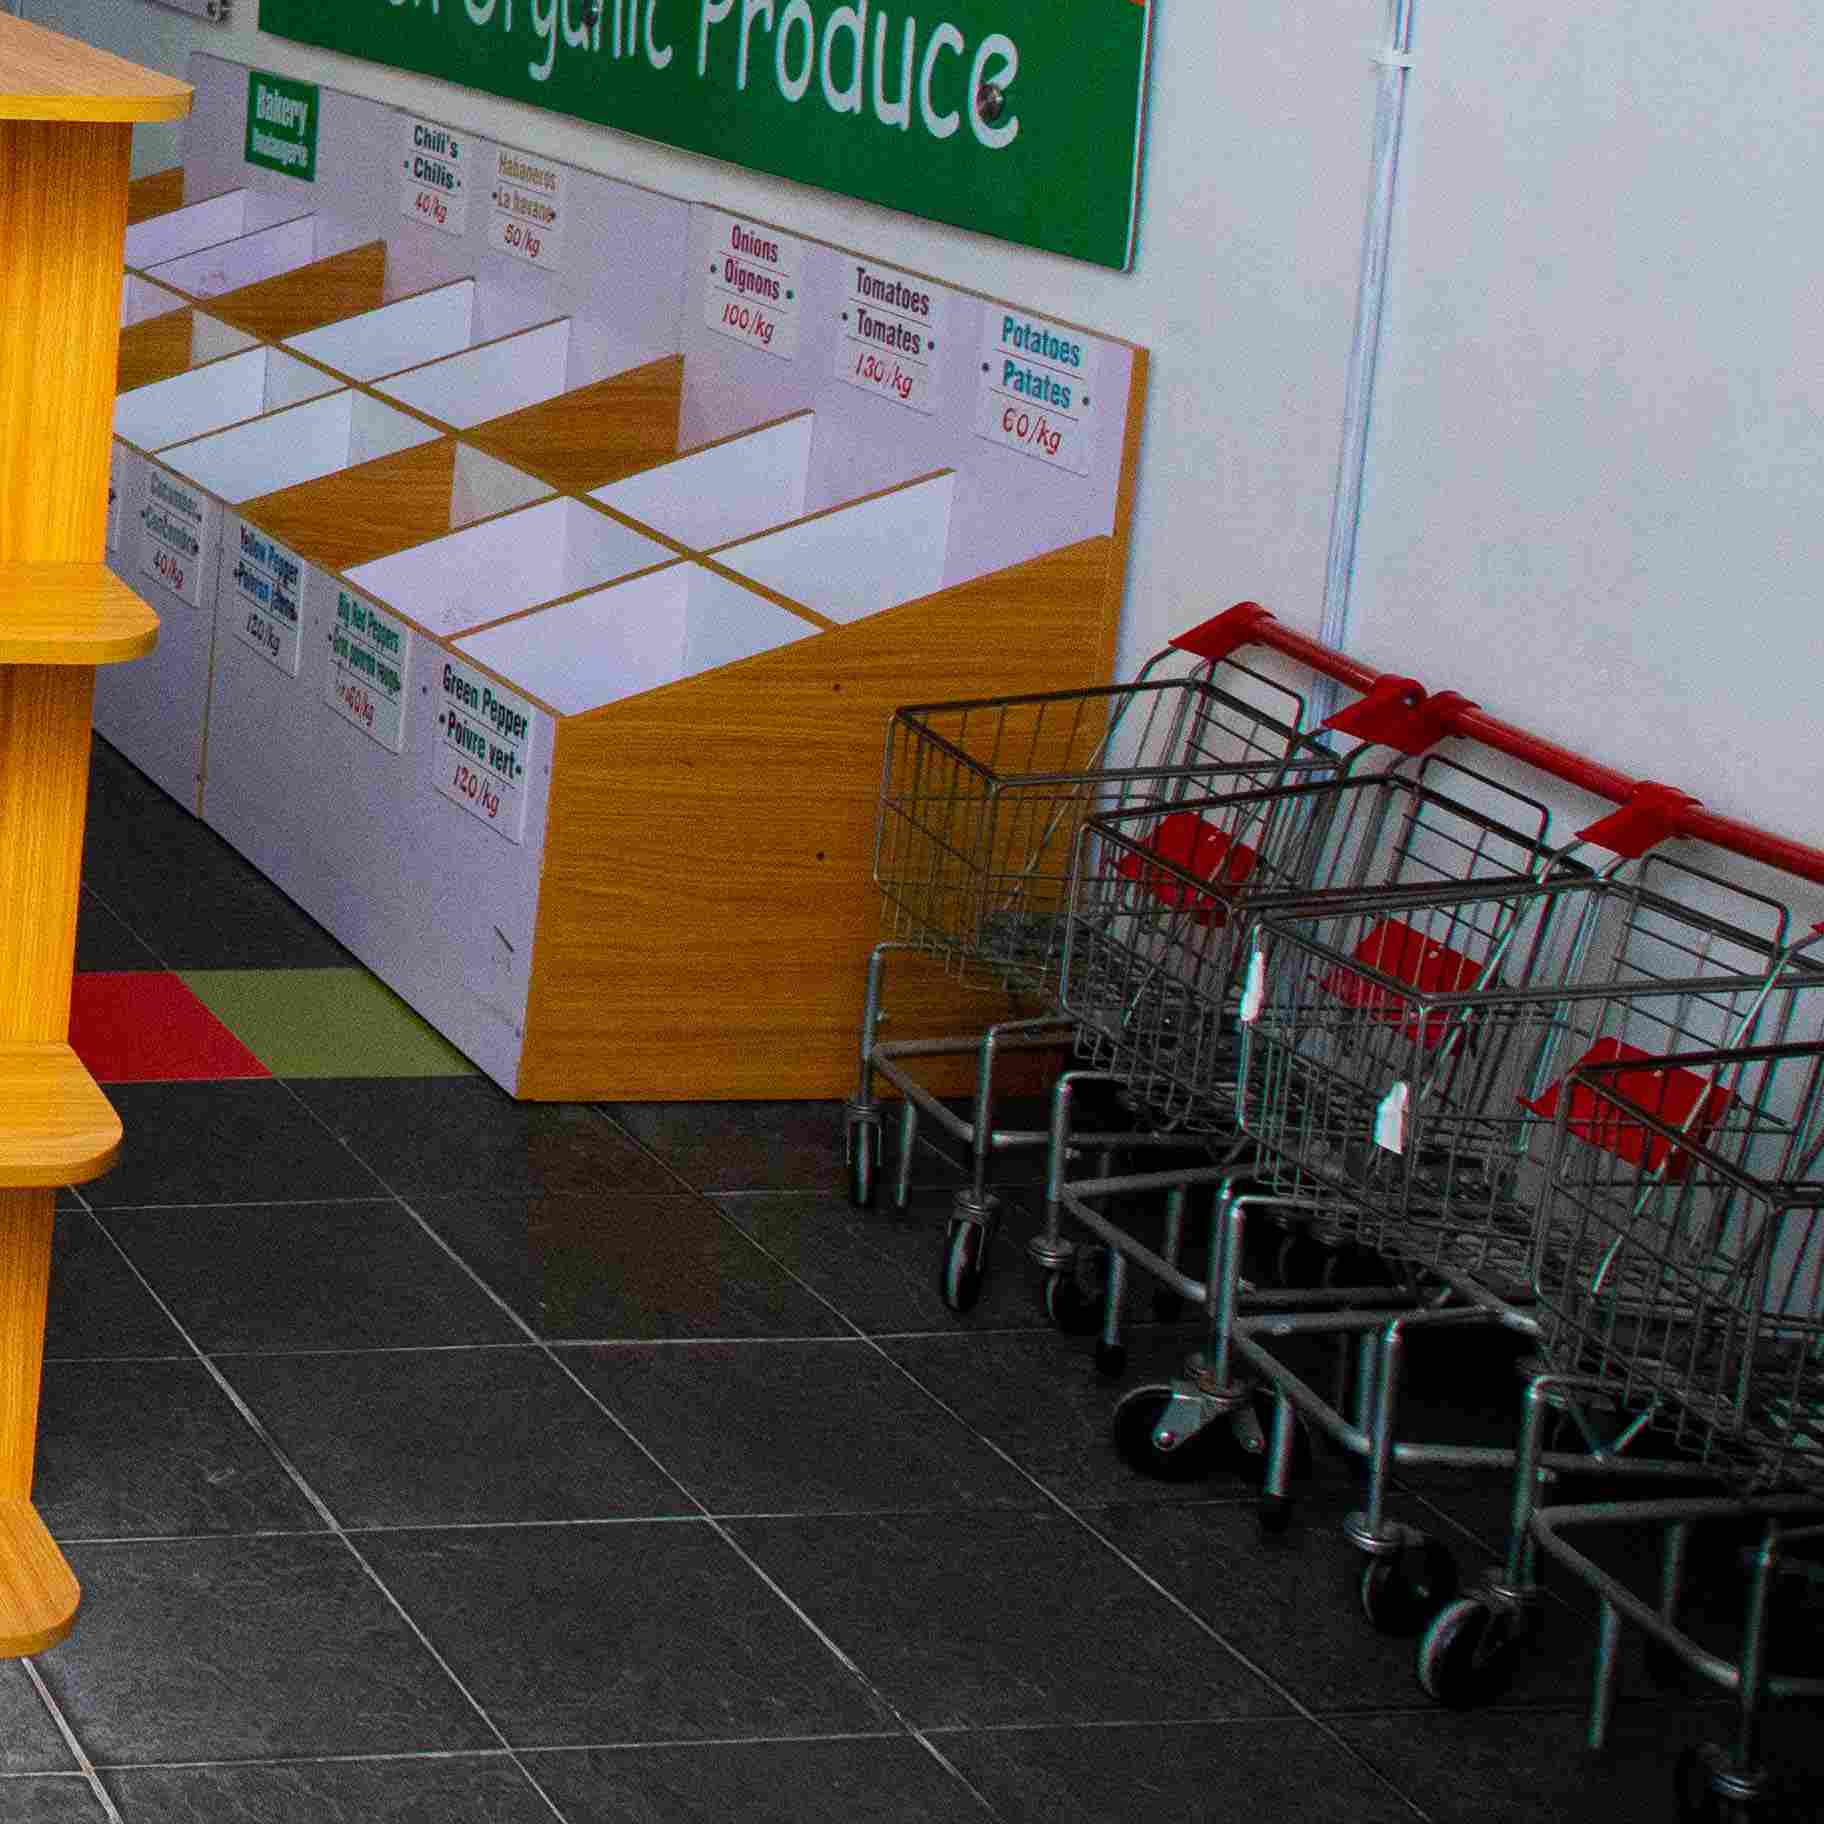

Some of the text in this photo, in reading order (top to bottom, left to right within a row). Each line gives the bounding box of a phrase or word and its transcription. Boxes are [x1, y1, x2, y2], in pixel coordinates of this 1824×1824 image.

[255, 82, 309, 136] Bakery
[731, 224, 779, 265] Onions
[724, 257, 781, 303] Oignons
[856, 266, 930, 318] Tomatoes
[720, 302, 776, 345] 100/kg
[857, 308, 921, 356] Tomates
[1001, 314, 1082, 369] Potatoes
[855, 351, 914, 400] 130/kg
[1002, 359, 1072, 410] Patates
[1000, 405, 1063, 456] 60/kg
[443, 663, 528, 740] Green Pepper
[447, 710, 516, 781] Poivre vert
[453, 764, 500, 819] 120/kg
